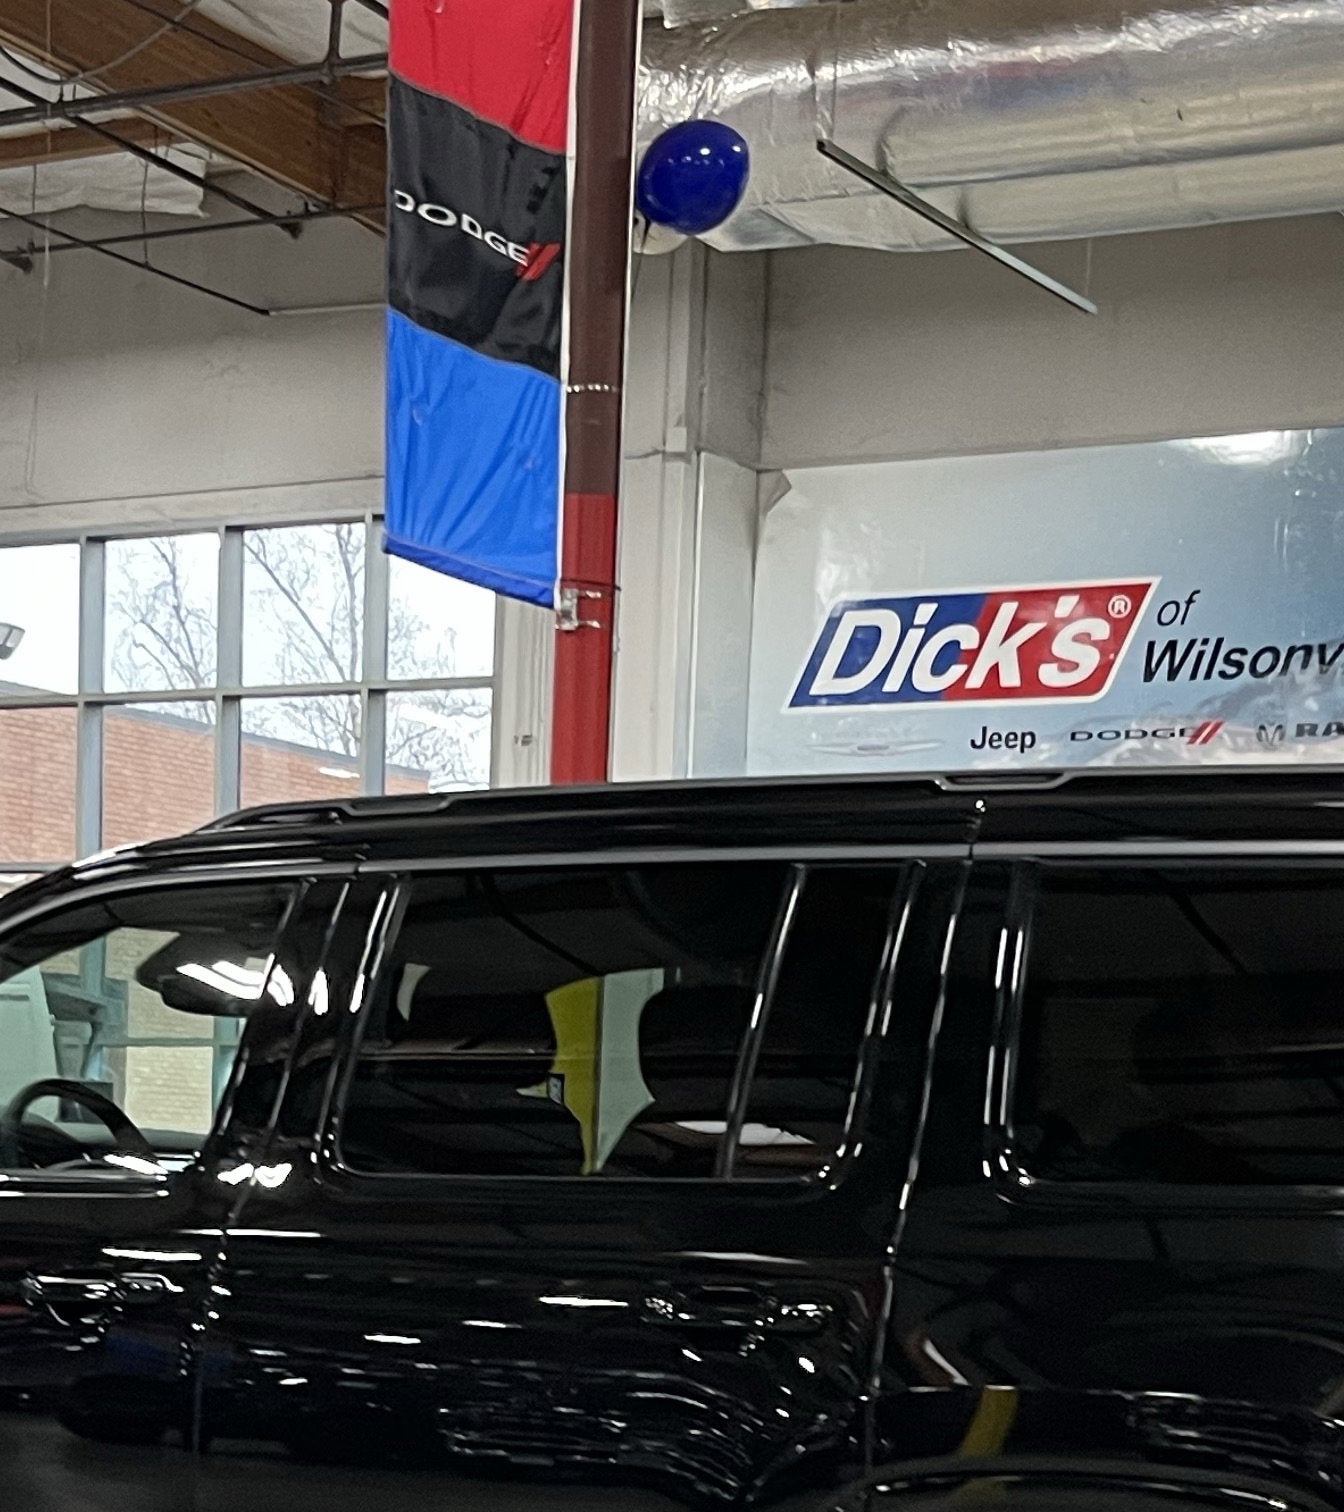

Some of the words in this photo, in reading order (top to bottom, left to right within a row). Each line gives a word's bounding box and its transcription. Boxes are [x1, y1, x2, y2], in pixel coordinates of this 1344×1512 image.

[394, 189, 529, 267] DODGE
[1156, 590, 1201, 626] of
[808, 595, 1111, 696] Dick's
[970, 726, 1036, 753] Jeep
